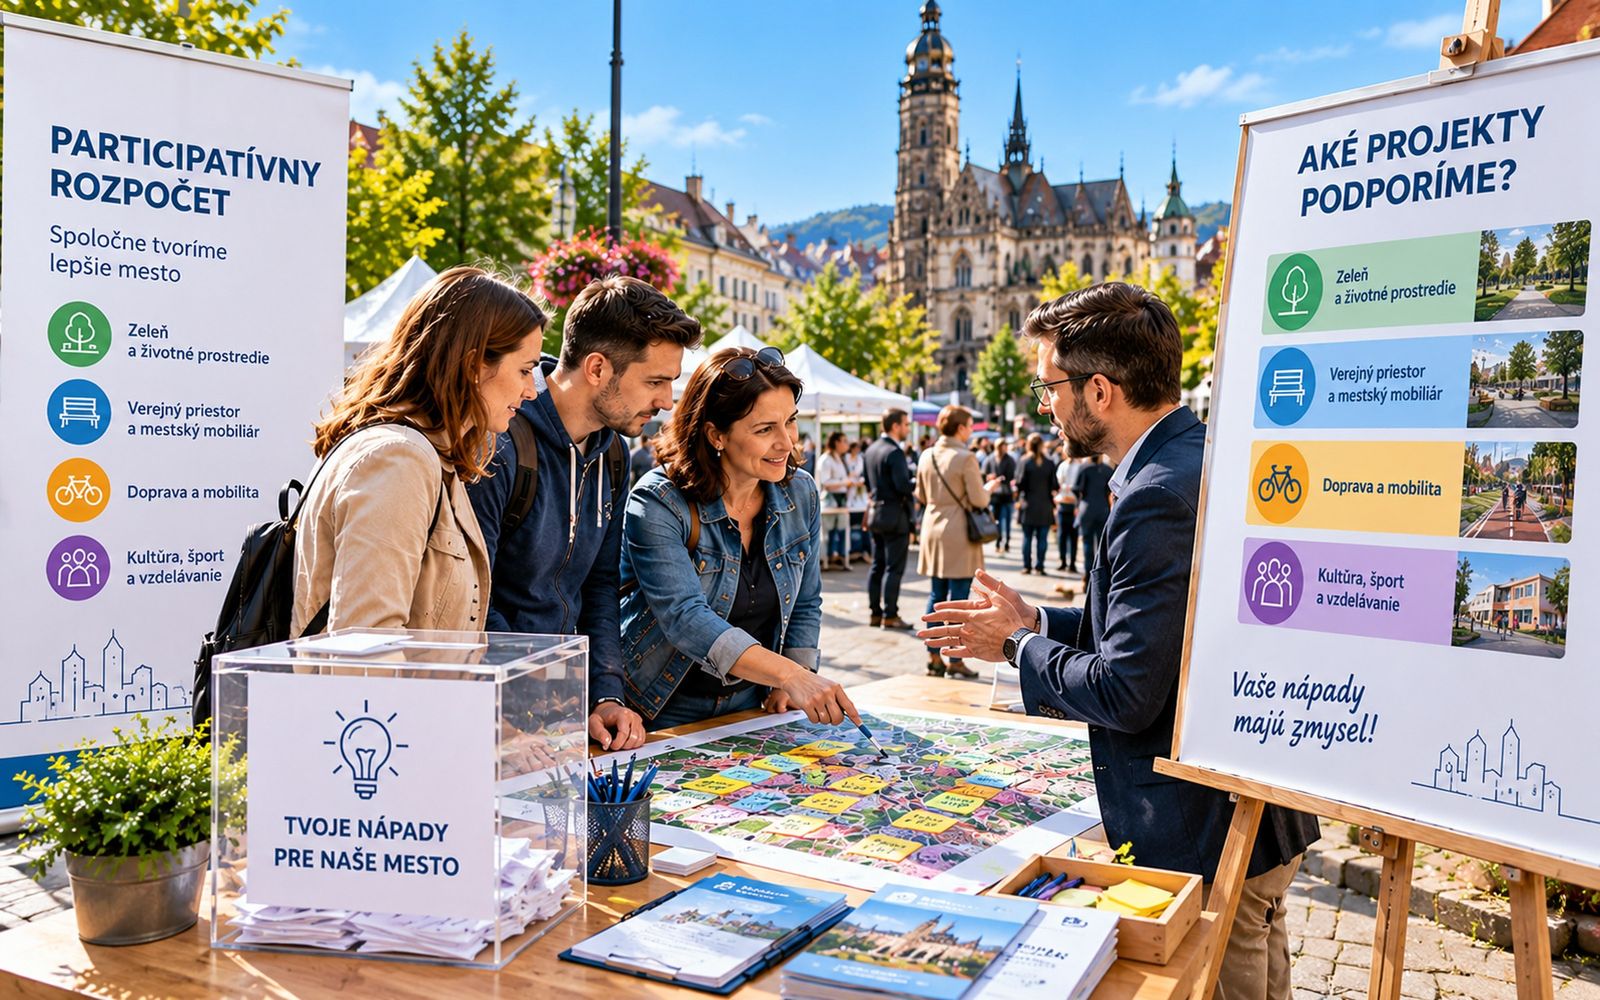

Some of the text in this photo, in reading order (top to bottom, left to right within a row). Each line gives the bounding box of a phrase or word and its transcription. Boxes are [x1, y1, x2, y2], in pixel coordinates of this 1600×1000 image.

[1298, 105, 1545, 174] AKÉ PROJEKTY
[51, 125, 321, 187] PARTICIPATÍVNY
[51, 168, 231, 216] ROZPOČET
[1301, 159, 1517, 217] PODPORÍME?
[51, 225, 226, 260] Spoločne tvoríme
[51, 253, 180, 282] lepšie mesto
[1336, 267, 1368, 283] Zeleň
[1334, 280, 1456, 304] a životné prostredie
[128, 324, 168, 338] Zeleň
[128, 344, 269, 364] a životné prostredie
[1330, 364, 1426, 383] Verejný priestor
[1327, 385, 1443, 405] a mestský mobiliár
[128, 401, 240, 419] Verejný priestor
[128, 423, 259, 439] a mestský mobiliár
[128, 485, 258, 501] Doprava a mobilita
[1323, 478, 1441, 496] Doprava a mobilita
[188, 549, 224, 565] šport
[127, 569, 221, 585] a vzdelávanie
[1370, 571, 1404, 590] šport
[1316, 592, 1399, 611] a vzdelávanie
[1234, 671, 1365, 714] Vaše nápady
[1234, 710, 1378, 749] majú zmysel!
[284, 816, 448, 842] TVOJE NÁPADY
[275, 847, 459, 876] PRE NAŠE MESTO
